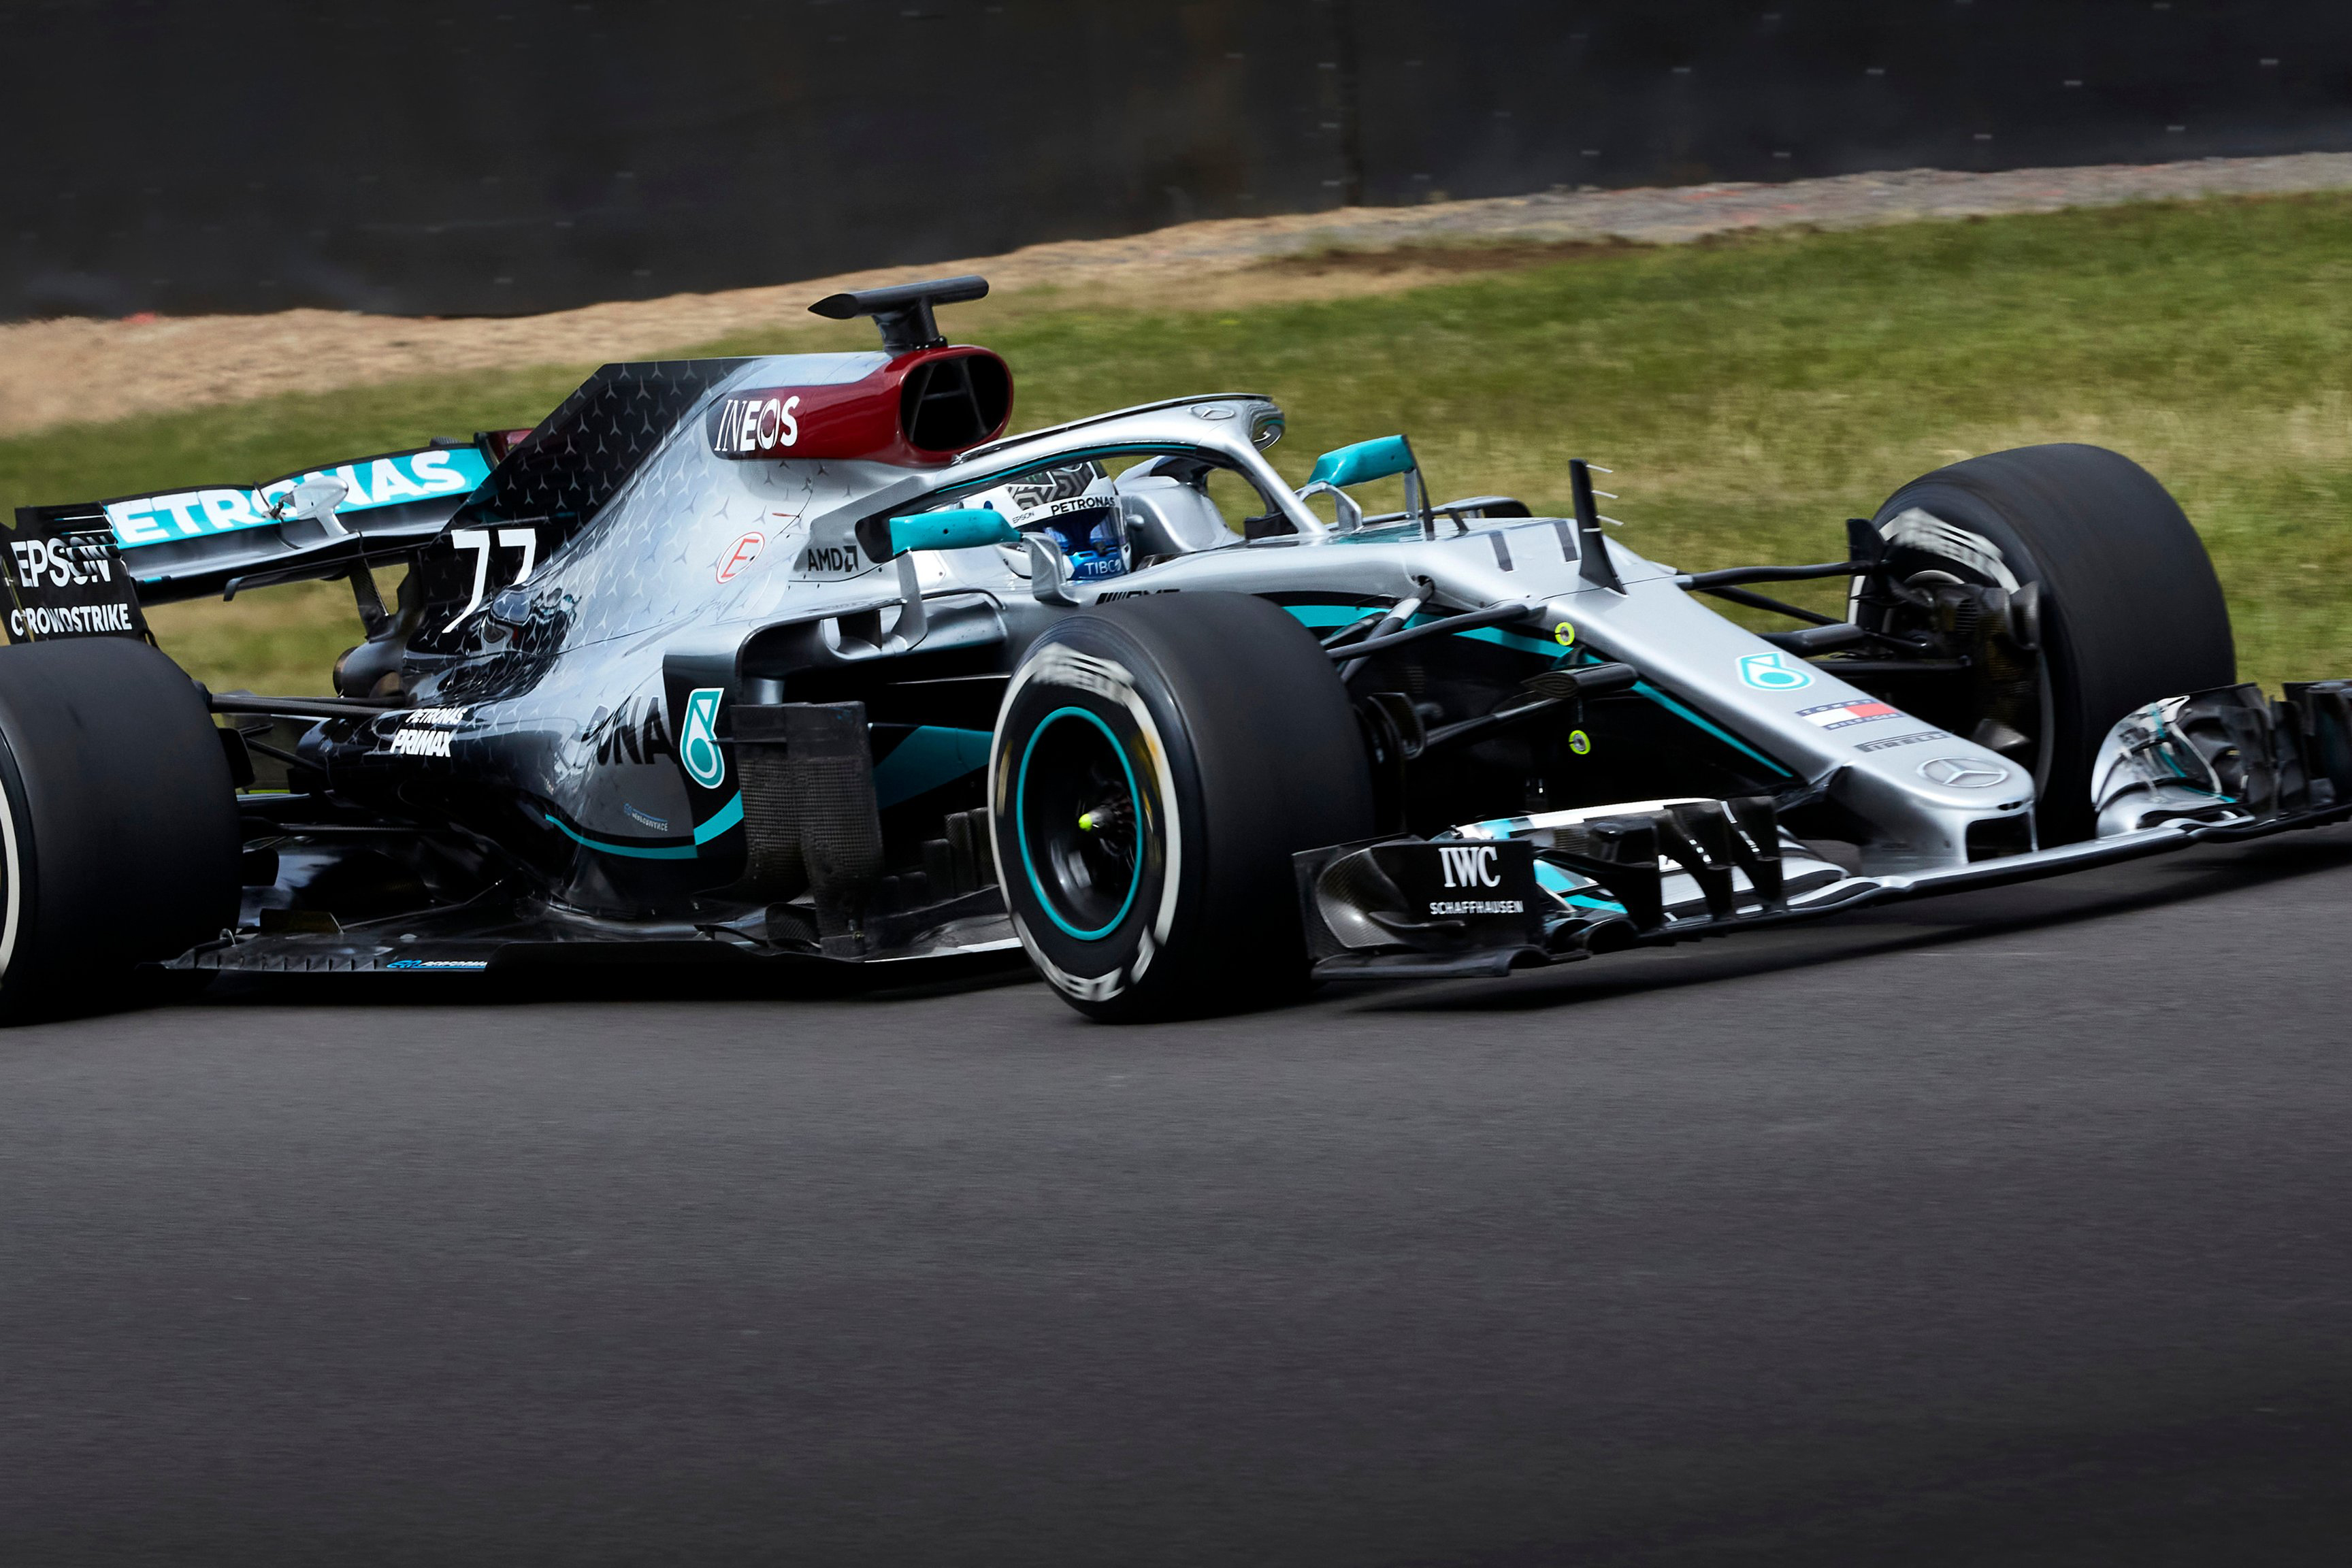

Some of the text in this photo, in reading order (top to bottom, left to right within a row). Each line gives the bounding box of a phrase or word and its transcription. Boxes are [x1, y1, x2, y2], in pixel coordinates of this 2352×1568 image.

[715, 395, 800, 451] INEOS
[1012, 511, 1035, 524] EPSON
[1050, 496, 1116, 516] PETRONAS
[10, 536, 112, 587] EPSON
[808, 547, 843, 572] AMD
[442, 528, 536, 634] 77
[11, 604, 132, 636] CROWDSTRIKE
[406, 708, 468, 725] PETRONAS
[389, 728, 458, 757] PRIMAX
[1853, 731, 1951, 753] PIRELLI
[1438, 846, 1501, 887] IWC
[1430, 900, 1524, 915] SCHAFFHAUSEN
